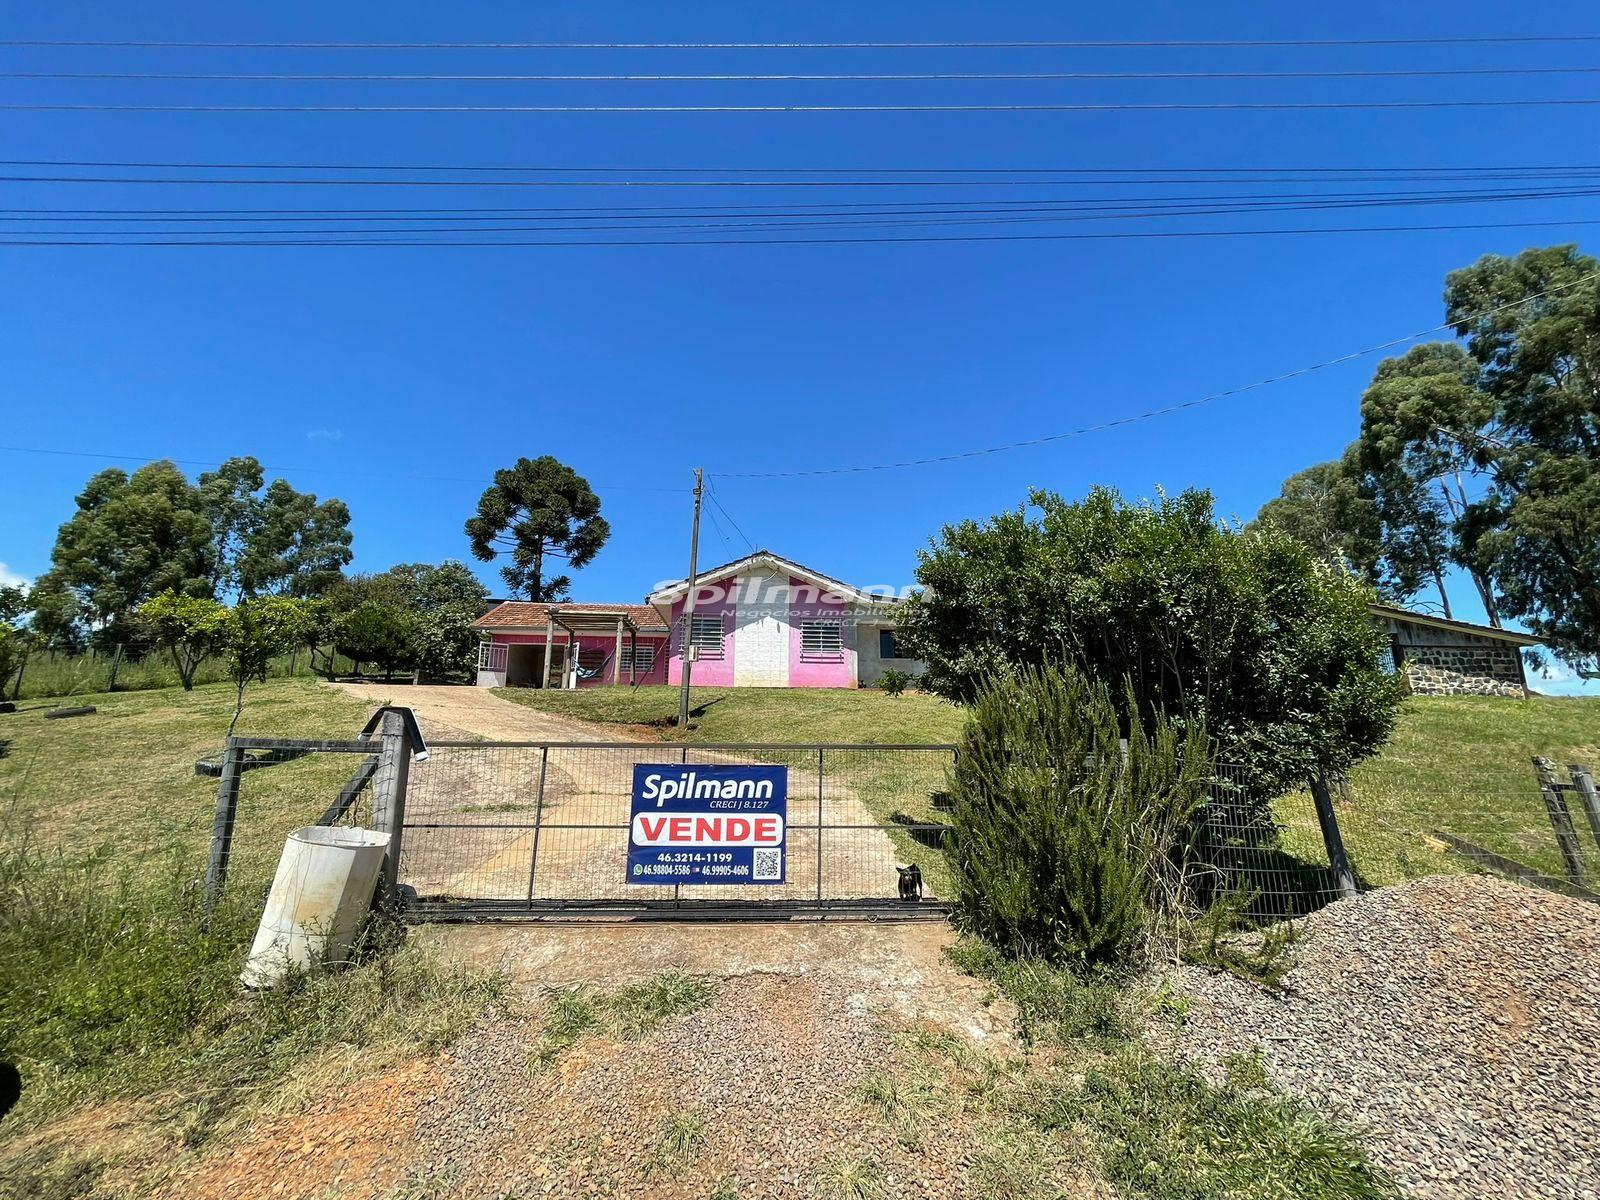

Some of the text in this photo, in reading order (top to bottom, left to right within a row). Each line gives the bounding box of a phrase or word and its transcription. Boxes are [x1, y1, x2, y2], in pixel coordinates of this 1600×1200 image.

[642, 772, 773, 807] Spilmann
[709, 800, 737, 809] CRECI
[743, 800, 769, 809] 8.127
[640, 817, 777, 841] VENDE
[657, 853, 733, 863] 46.3214-1199
[643, 864, 749, 875] 46.98804-5586 46.99905-4606
